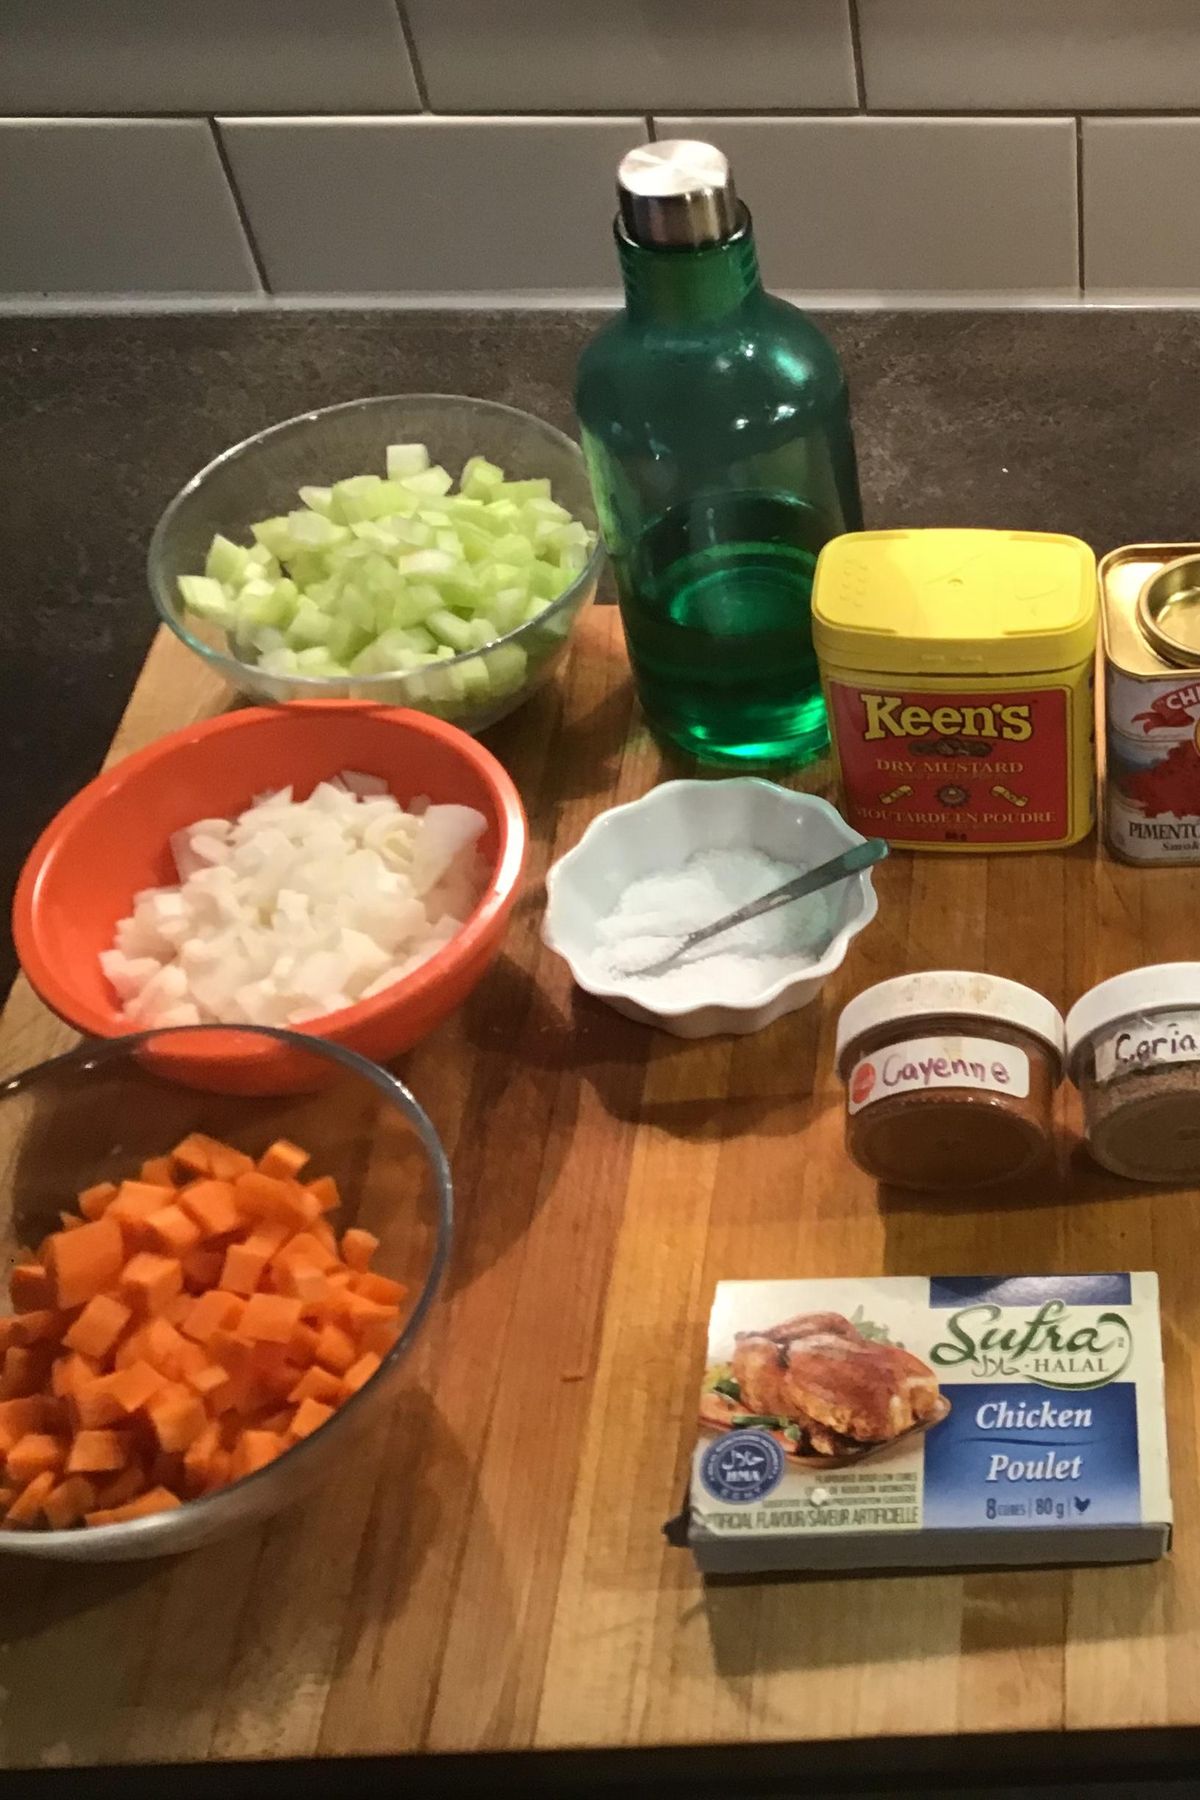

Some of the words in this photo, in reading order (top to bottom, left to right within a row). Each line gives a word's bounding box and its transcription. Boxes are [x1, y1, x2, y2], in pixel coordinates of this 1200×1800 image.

[860, 693, 1033, 741] Keen's
[876, 758, 915, 774] DRY
[924, 761, 1024, 775] MUSTARD
[856, 807, 949, 824] MOUTARDE
[955, 812, 980, 824] EN
[983, 811, 1056, 824] POUDRE
[881, 1054, 1010, 1087] Cayenne
[929, 1300, 1117, 1366] Sufra
[1034, 1358, 1110, 1373] HALAL
[976, 1400, 1093, 1429] Chicken
[986, 1451, 1084, 1481] Poulet
[986, 1498, 997, 1520] 8
[1036, 1497, 1054, 1516] 80
[1056, 1502, 1065, 1519] g
